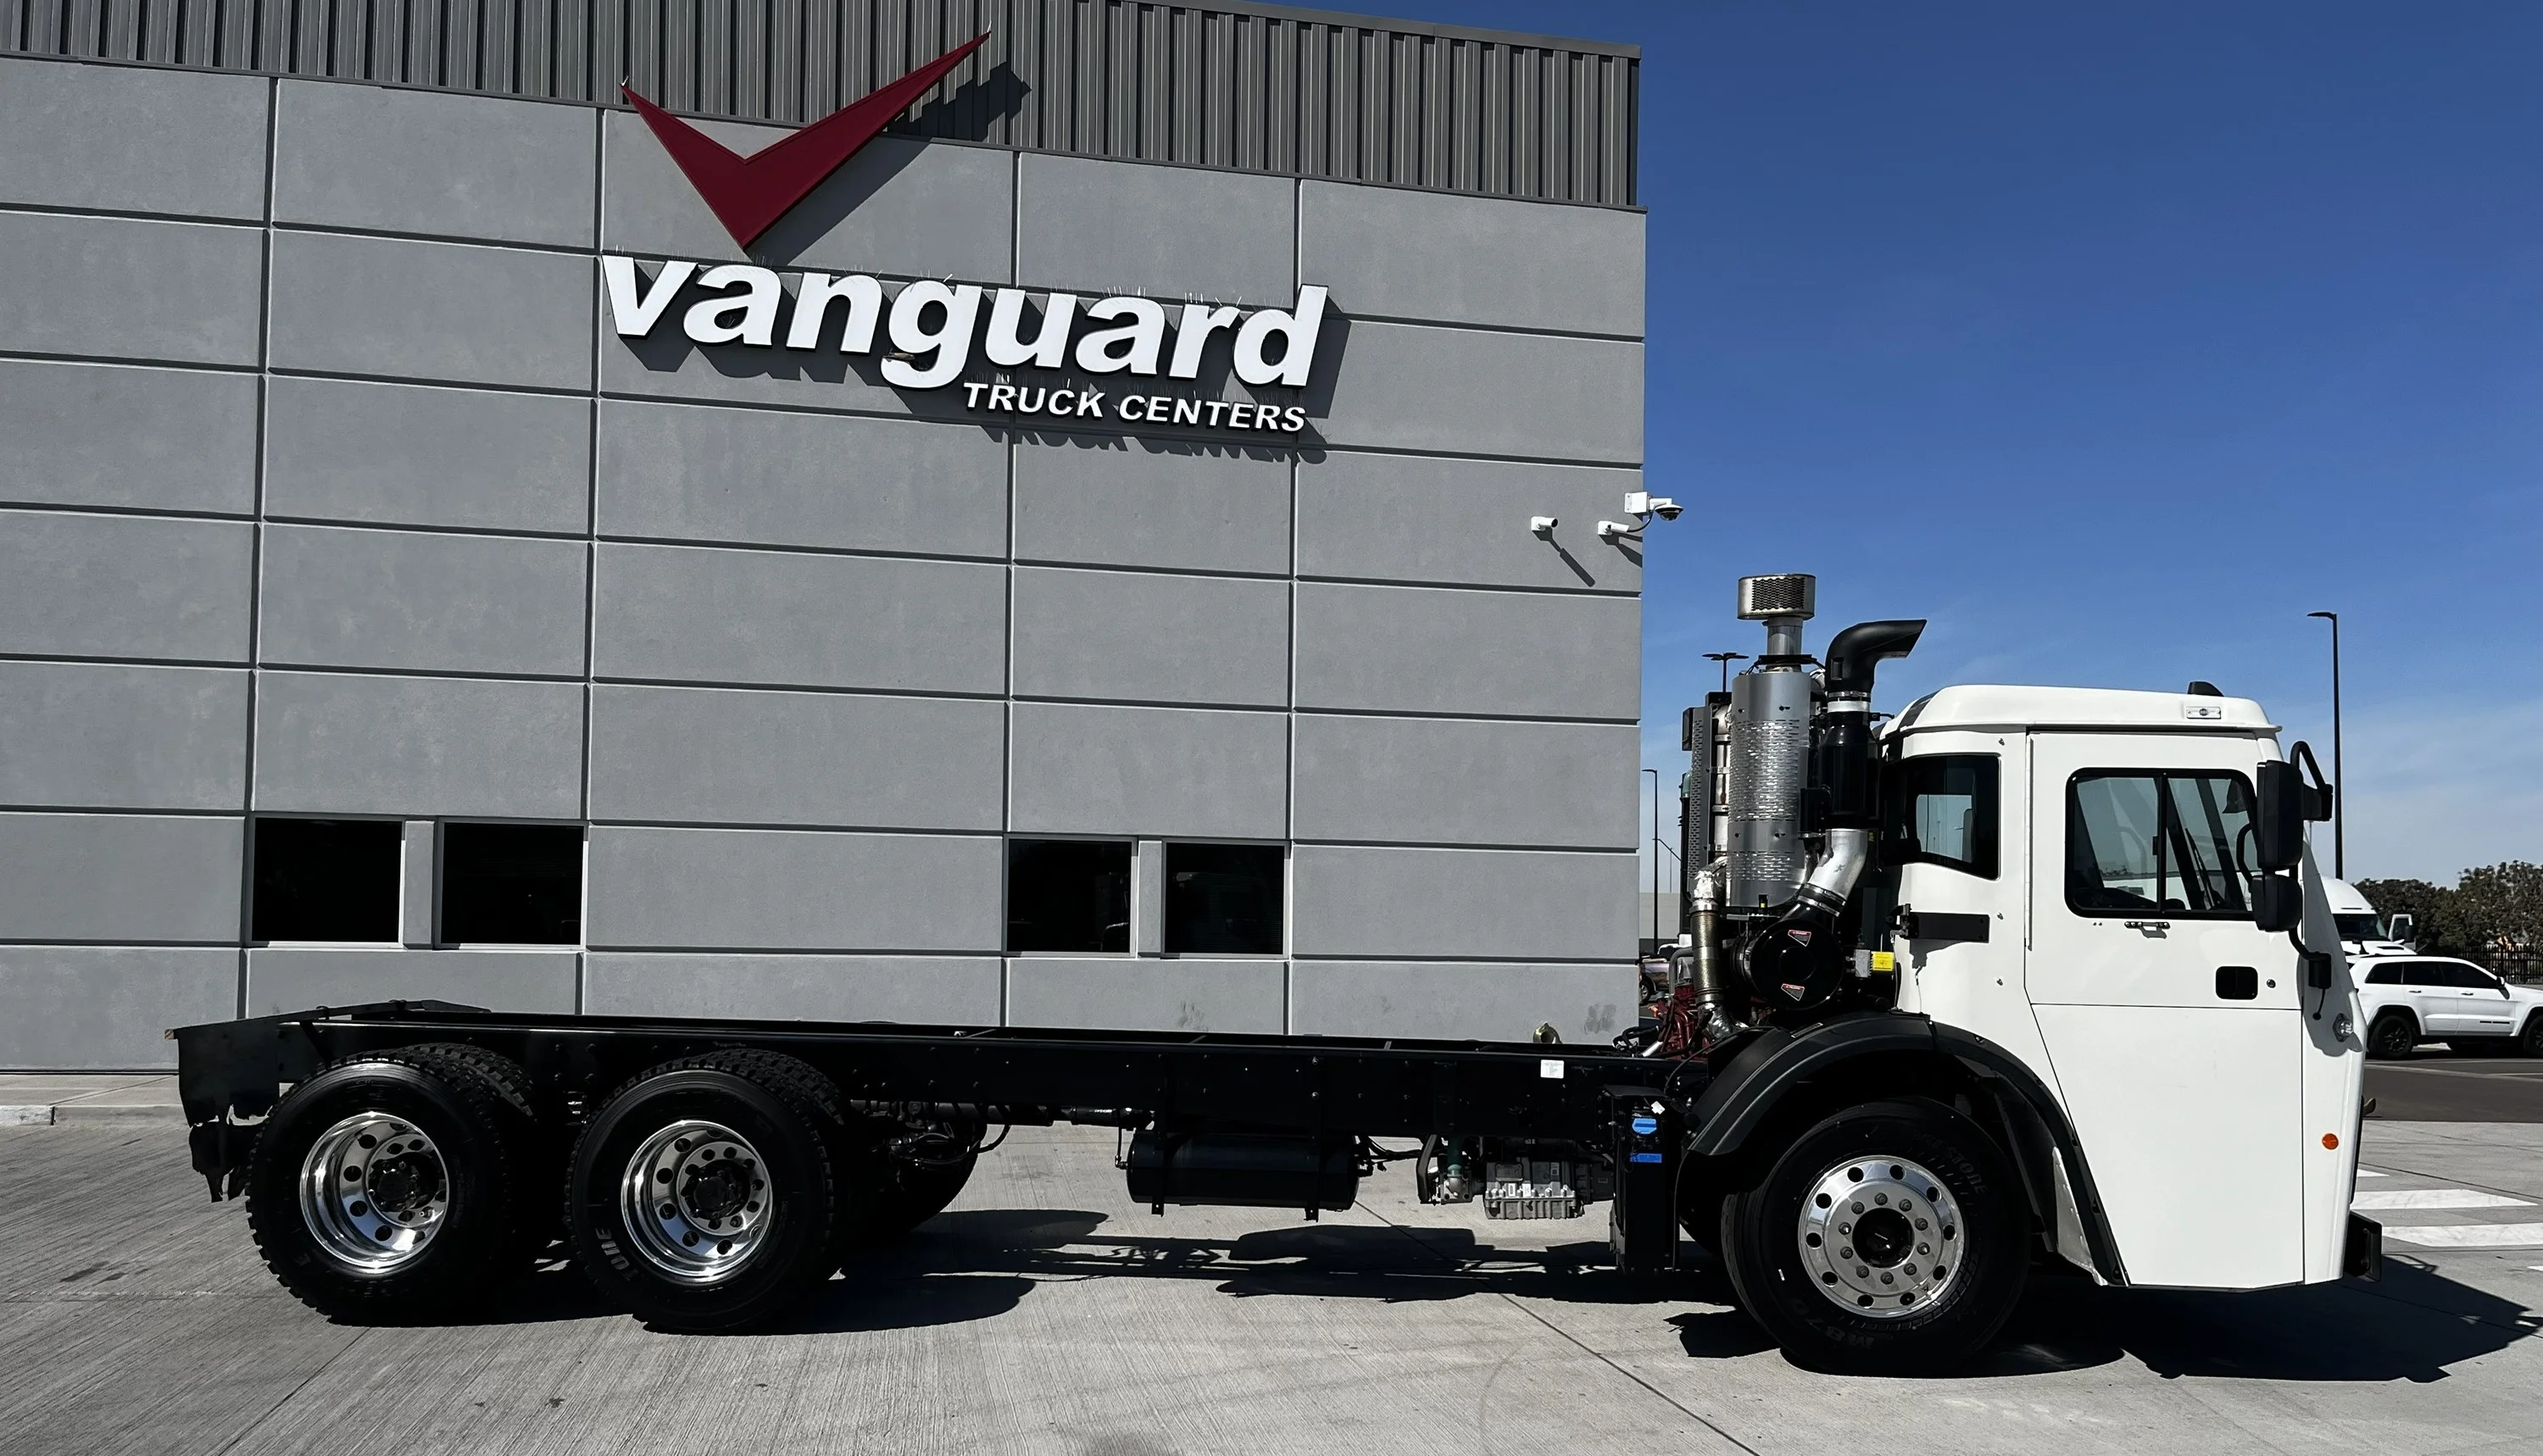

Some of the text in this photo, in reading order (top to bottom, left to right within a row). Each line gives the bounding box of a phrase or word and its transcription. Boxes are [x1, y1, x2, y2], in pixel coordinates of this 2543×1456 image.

[600, 254, 1329, 389] vanguard
[963, 381, 1307, 433] TRUCK CENTERS
